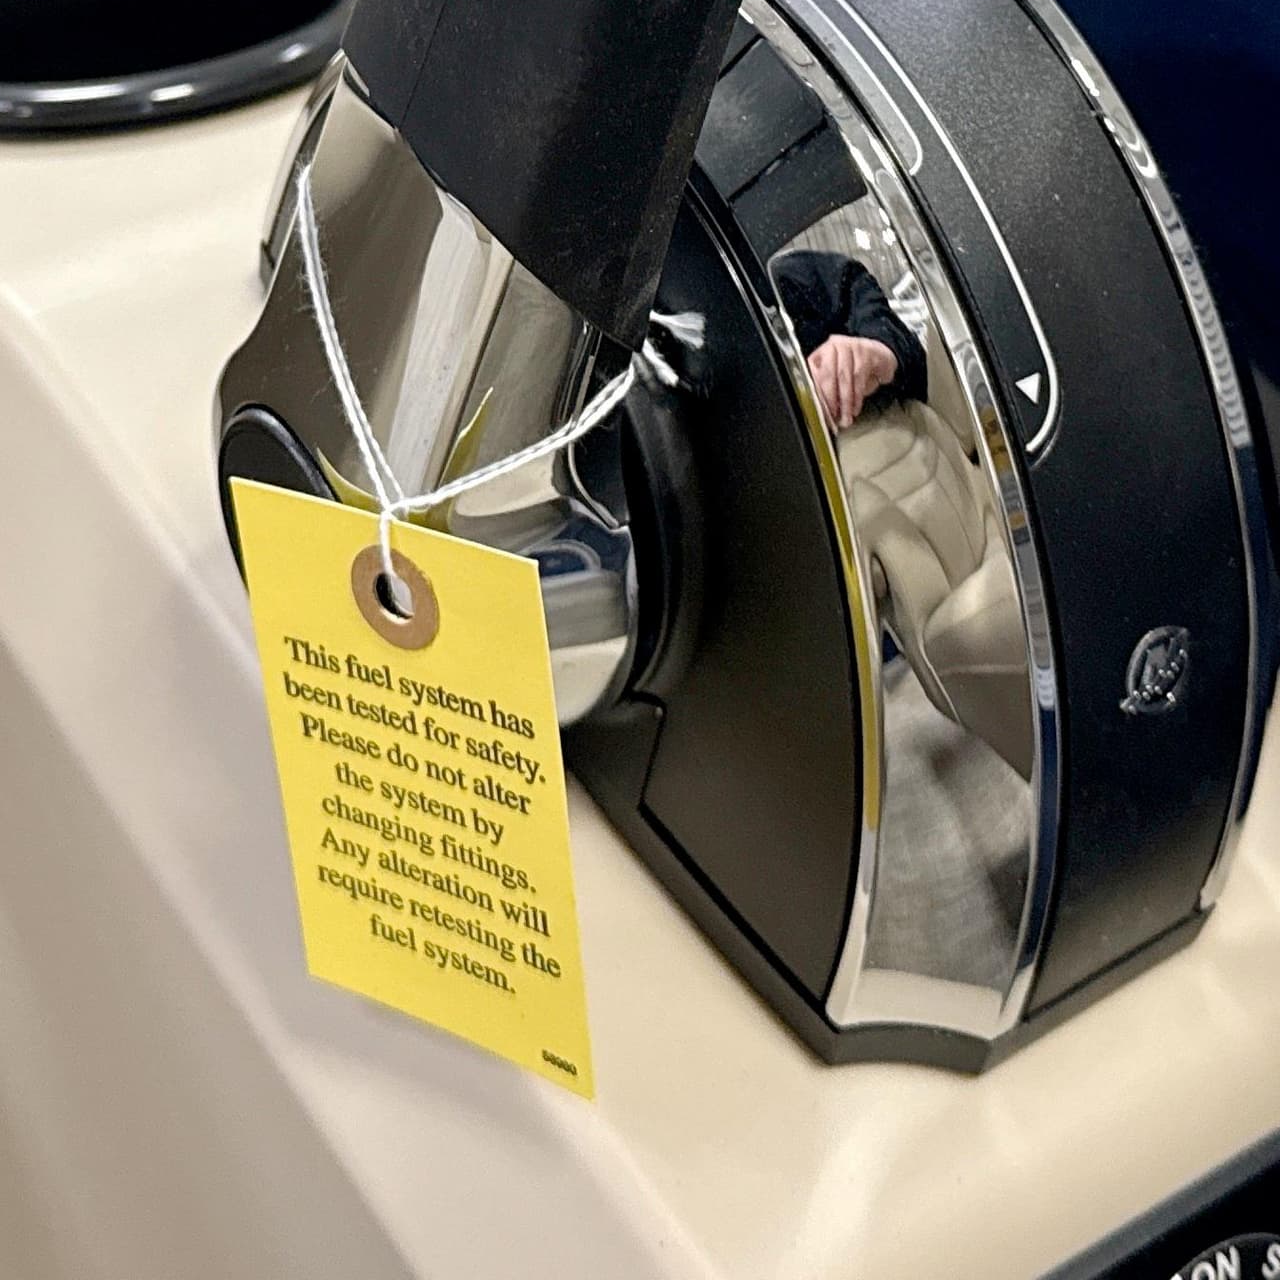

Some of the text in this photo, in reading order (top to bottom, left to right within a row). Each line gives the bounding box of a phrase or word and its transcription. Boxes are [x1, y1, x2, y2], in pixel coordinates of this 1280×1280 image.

[282, 671, 546, 786] been tested for safety.
[283, 636, 536, 740] This fuel system has
[299, 711, 532, 816] Please do not alter
[334, 761, 504, 846] the system by
[320, 827, 551, 938] Any alteration will
[321, 794, 537, 894] changing fittings.
[317, 864, 562, 979] require retesting the
[369, 913, 516, 995] fuel system.
